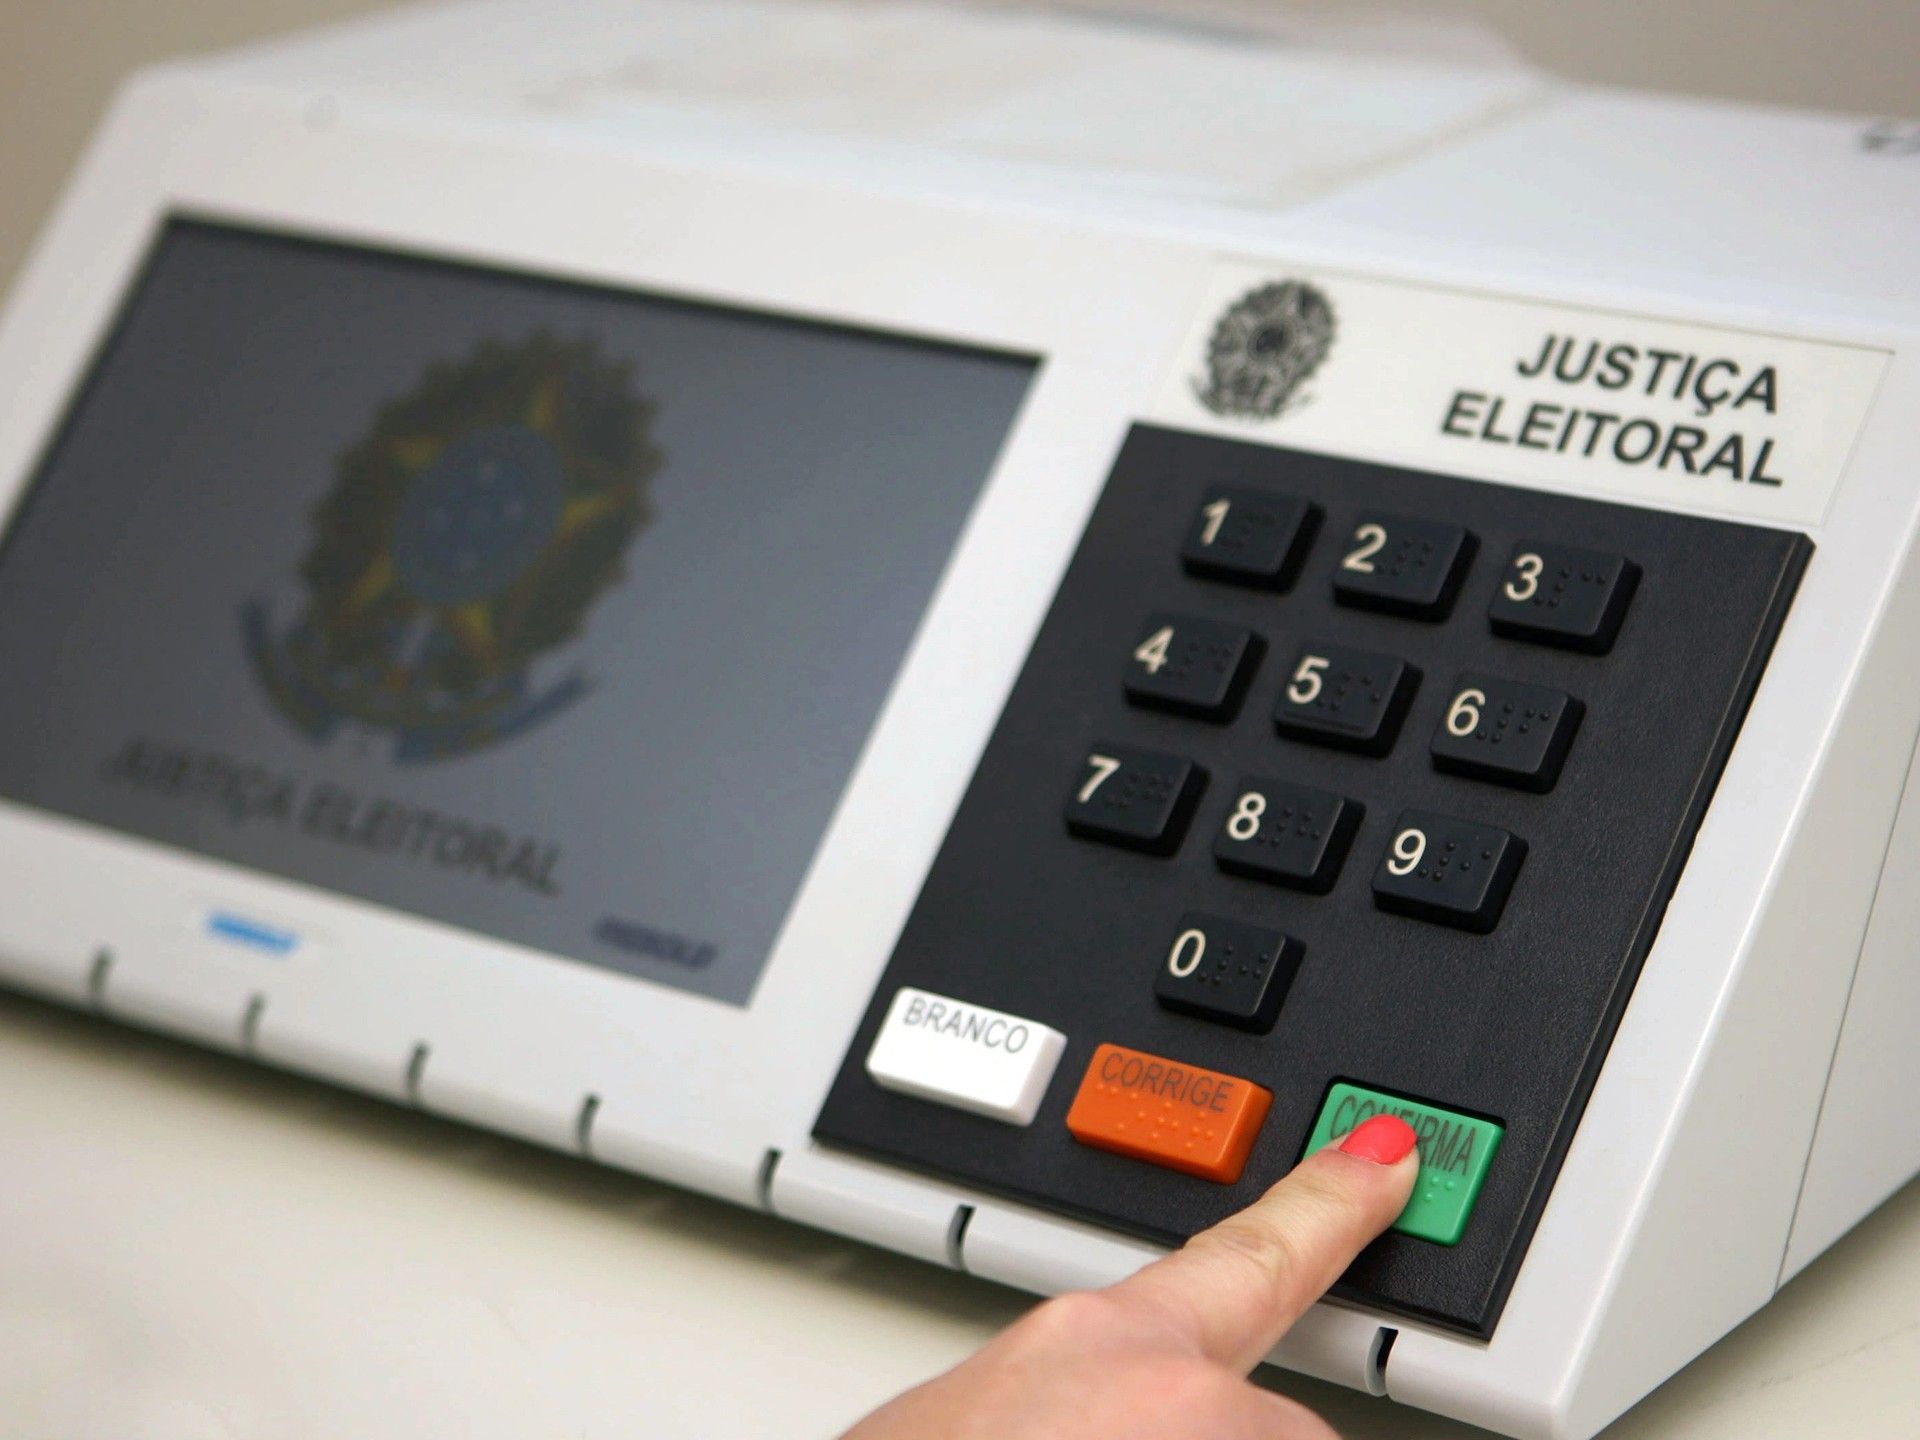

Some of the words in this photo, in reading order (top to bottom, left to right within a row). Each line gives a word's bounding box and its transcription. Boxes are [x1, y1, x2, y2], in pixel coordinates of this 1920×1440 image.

[1516, 334, 1778, 417] JUSTIÇA
[1441, 389, 1783, 488] ELEITORAL
[1202, 499, 1230, 545] 1
[1342, 523, 1388, 573] 2
[1505, 553, 1544, 601] 3
[1134, 627, 1175, 674] 4
[1287, 656, 1330, 704] 5
[1445, 688, 1486, 737] 6
[1077, 754, 1121, 803] 7
[1226, 792, 1267, 841] 8
[1387, 828, 1427, 877] 9
[1167, 928, 1206, 978] 0
[903, 997, 1029, 1054] BRANCO
[1101, 1053, 1233, 1113] CORRIGE
[1329, 1094, 1478, 1177] CORMA
